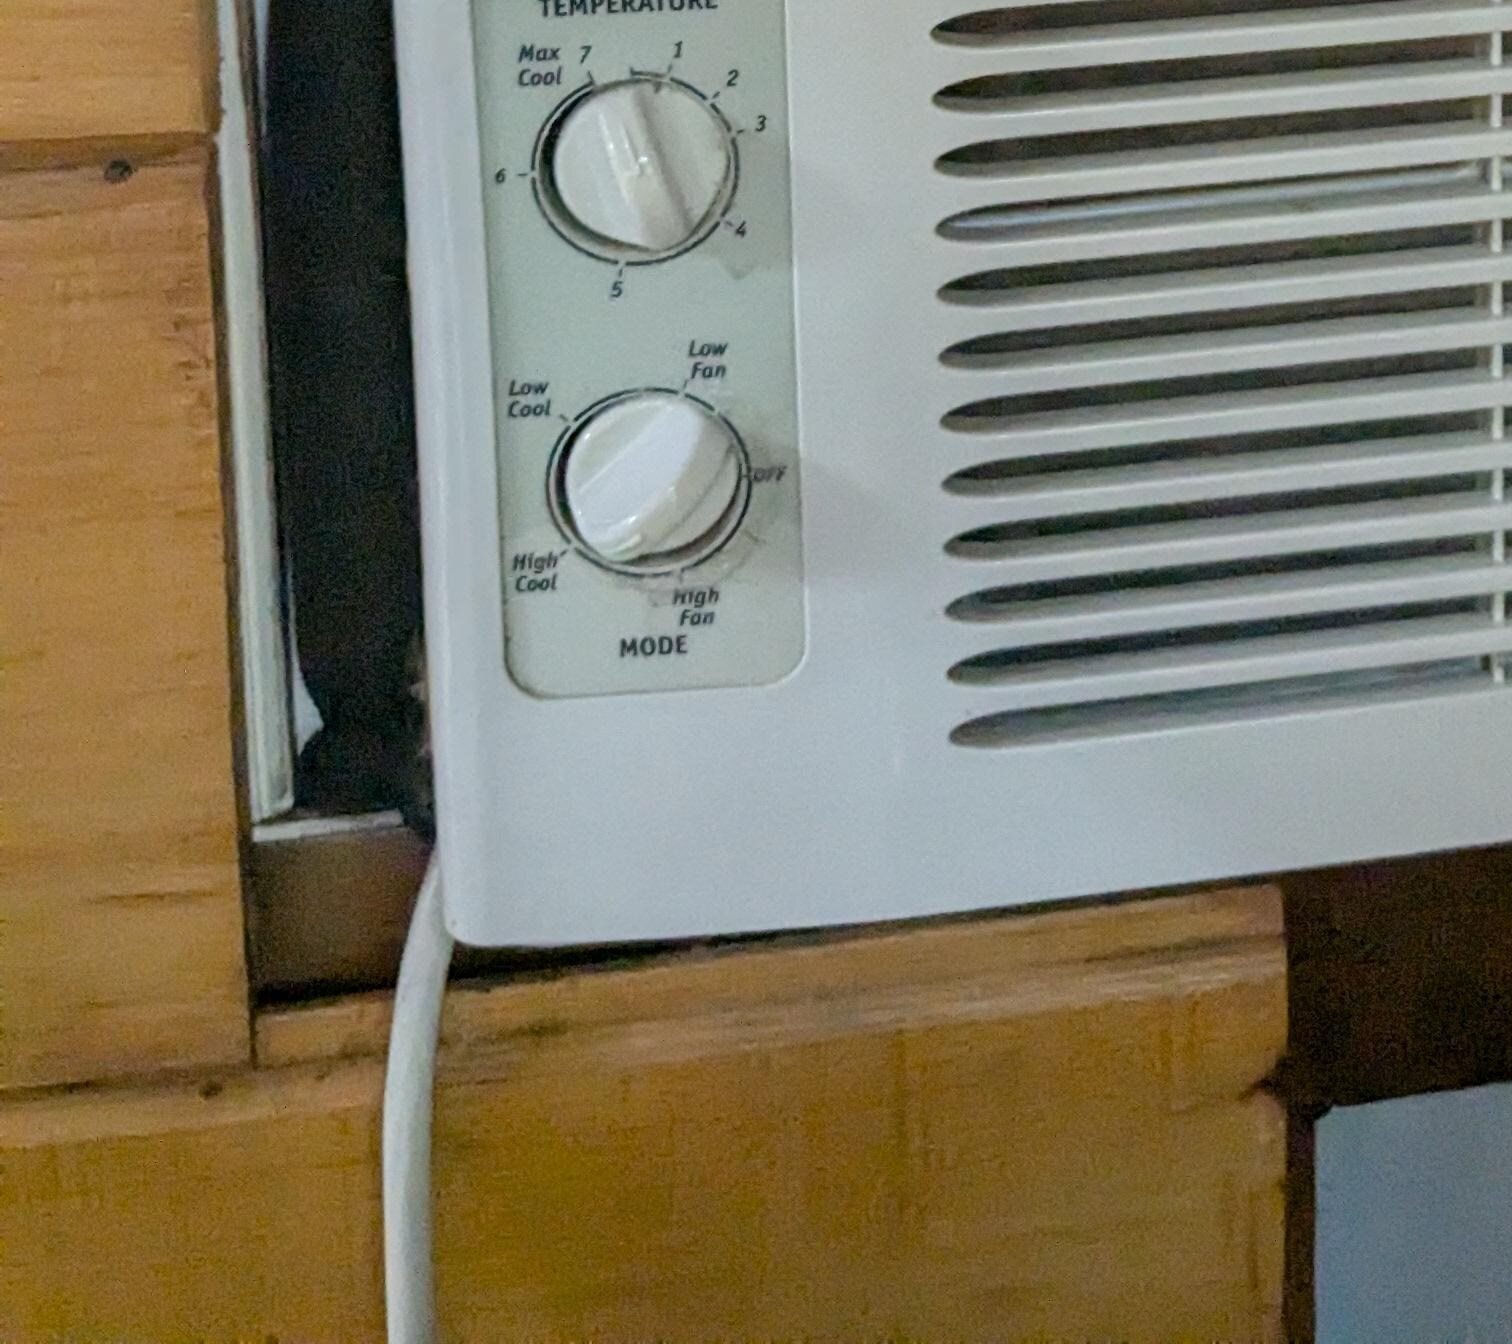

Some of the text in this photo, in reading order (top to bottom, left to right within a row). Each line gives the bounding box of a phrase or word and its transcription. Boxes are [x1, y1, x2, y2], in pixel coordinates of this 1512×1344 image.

[518, 44, 560, 63] Max
[578, 45, 591, 64] 7
[673, 42, 682, 58] 1
[518, 67, 562, 88] Cool
[726, 69, 738, 88] 2
[755, 115, 766, 132] 3
[495, 168, 505, 183] 6
[735, 220, 746, 237] 4
[611, 280, 622, 298] 5
[689, 340, 727, 358] Low
[691, 362, 727, 379] Fan
[508, 379, 548, 396] Low
[508, 400, 551, 418] Cool
[512, 554, 559, 573] High
[515, 575, 558, 592] Cool
[672, 587, 720, 607] High
[679, 609, 715, 626] Fan
[619, 634, 689, 659] MODE
